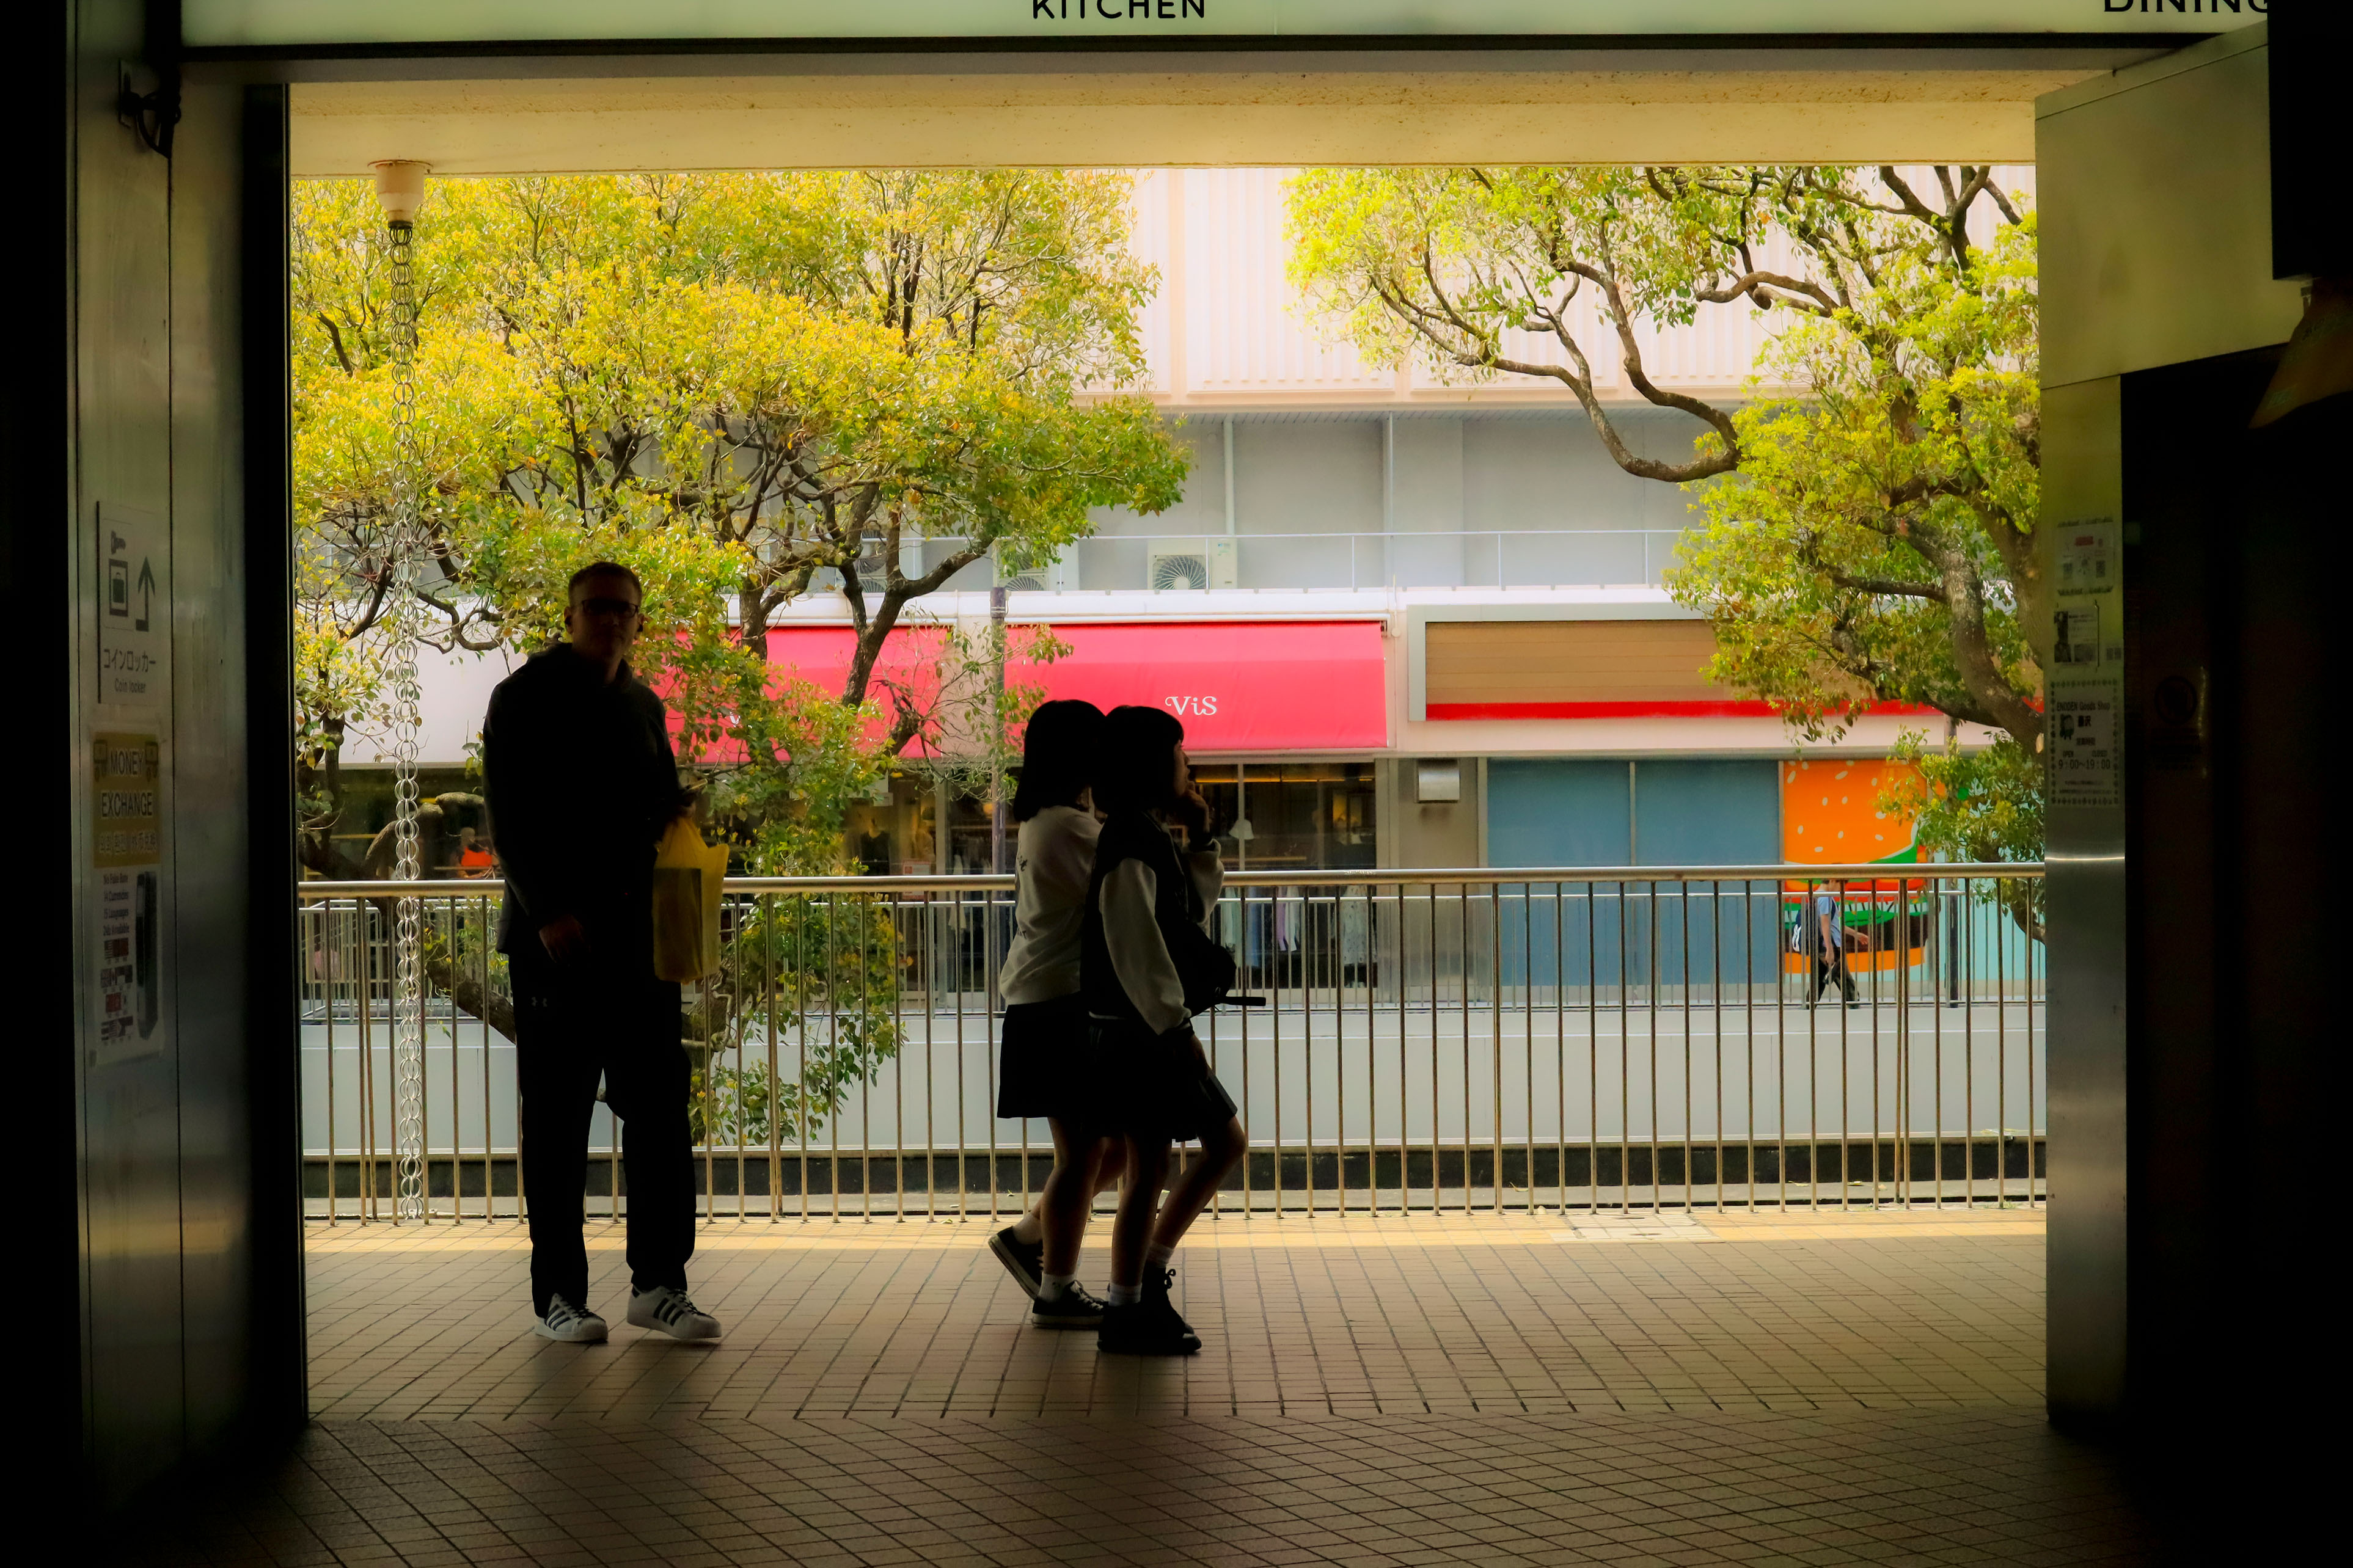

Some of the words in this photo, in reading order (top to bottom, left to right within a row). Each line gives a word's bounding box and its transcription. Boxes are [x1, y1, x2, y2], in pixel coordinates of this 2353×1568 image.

[104, 649, 156, 673] コインロッカー
[114, 677, 128, 692] Coin
[129, 679, 147, 693] locker
[1165, 696, 1217, 716] ViS
[110, 749, 144, 775] MONEY
[101, 792, 152, 817] EXCHANGE
